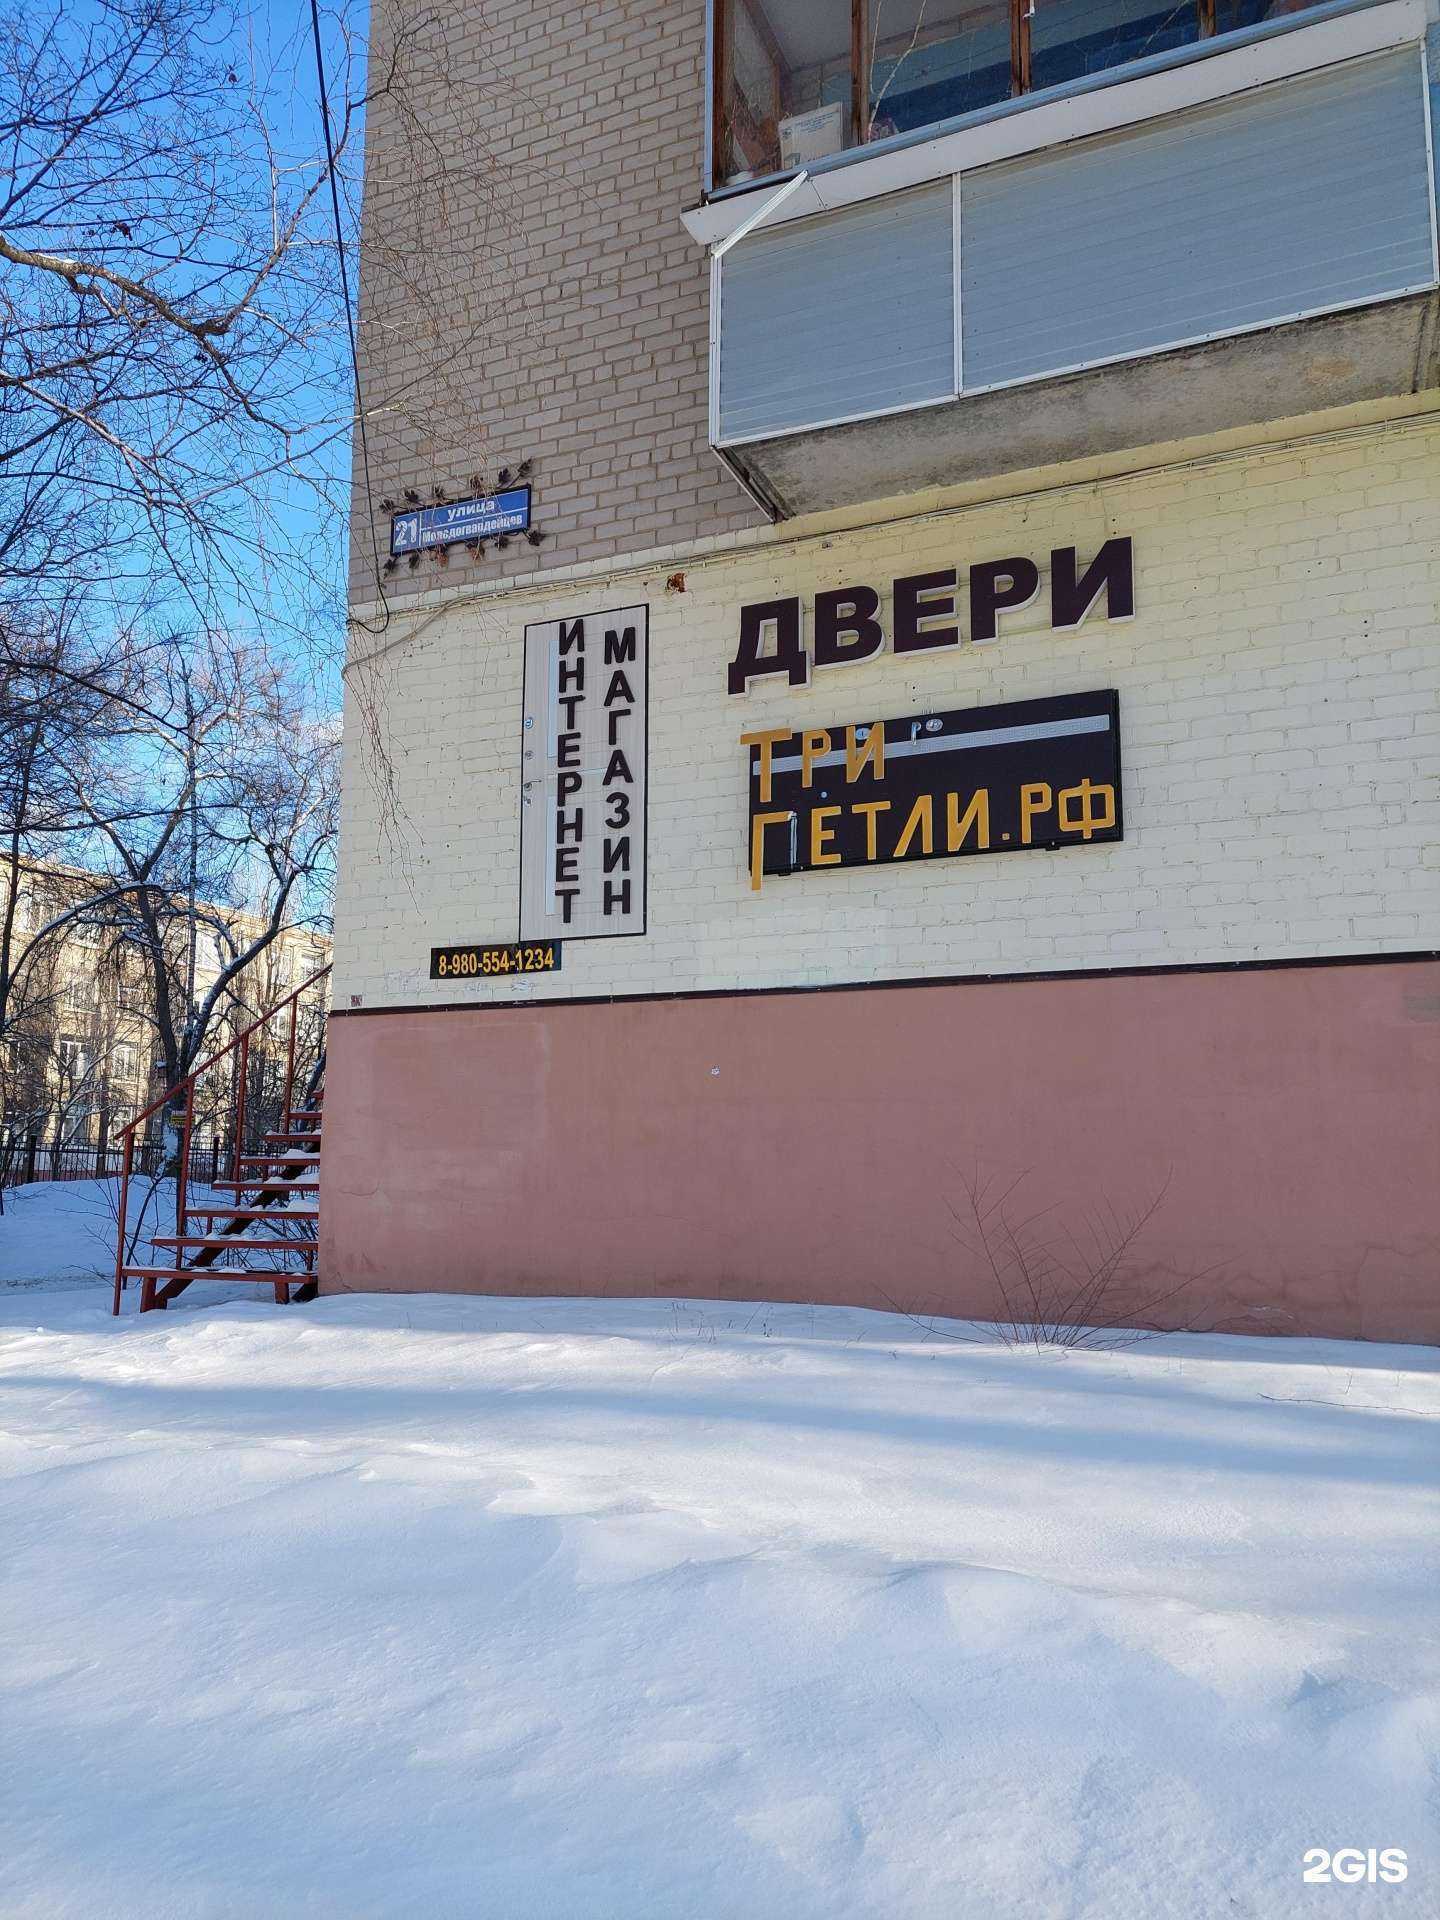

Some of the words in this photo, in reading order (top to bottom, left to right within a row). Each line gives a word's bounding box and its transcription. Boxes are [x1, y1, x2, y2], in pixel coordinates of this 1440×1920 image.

[394, 517, 417, 546] 21
[448, 500, 494, 521] улица
[727, 536, 1135, 697] ДВЕРИ
[554, 618, 585, 924] ИНТЕРНЕТ
[602, 626, 636, 916] МАГАЗИН
[740, 721, 885, 803] ТРИ
[438, 947, 554, 977] 8-980-554-1234
